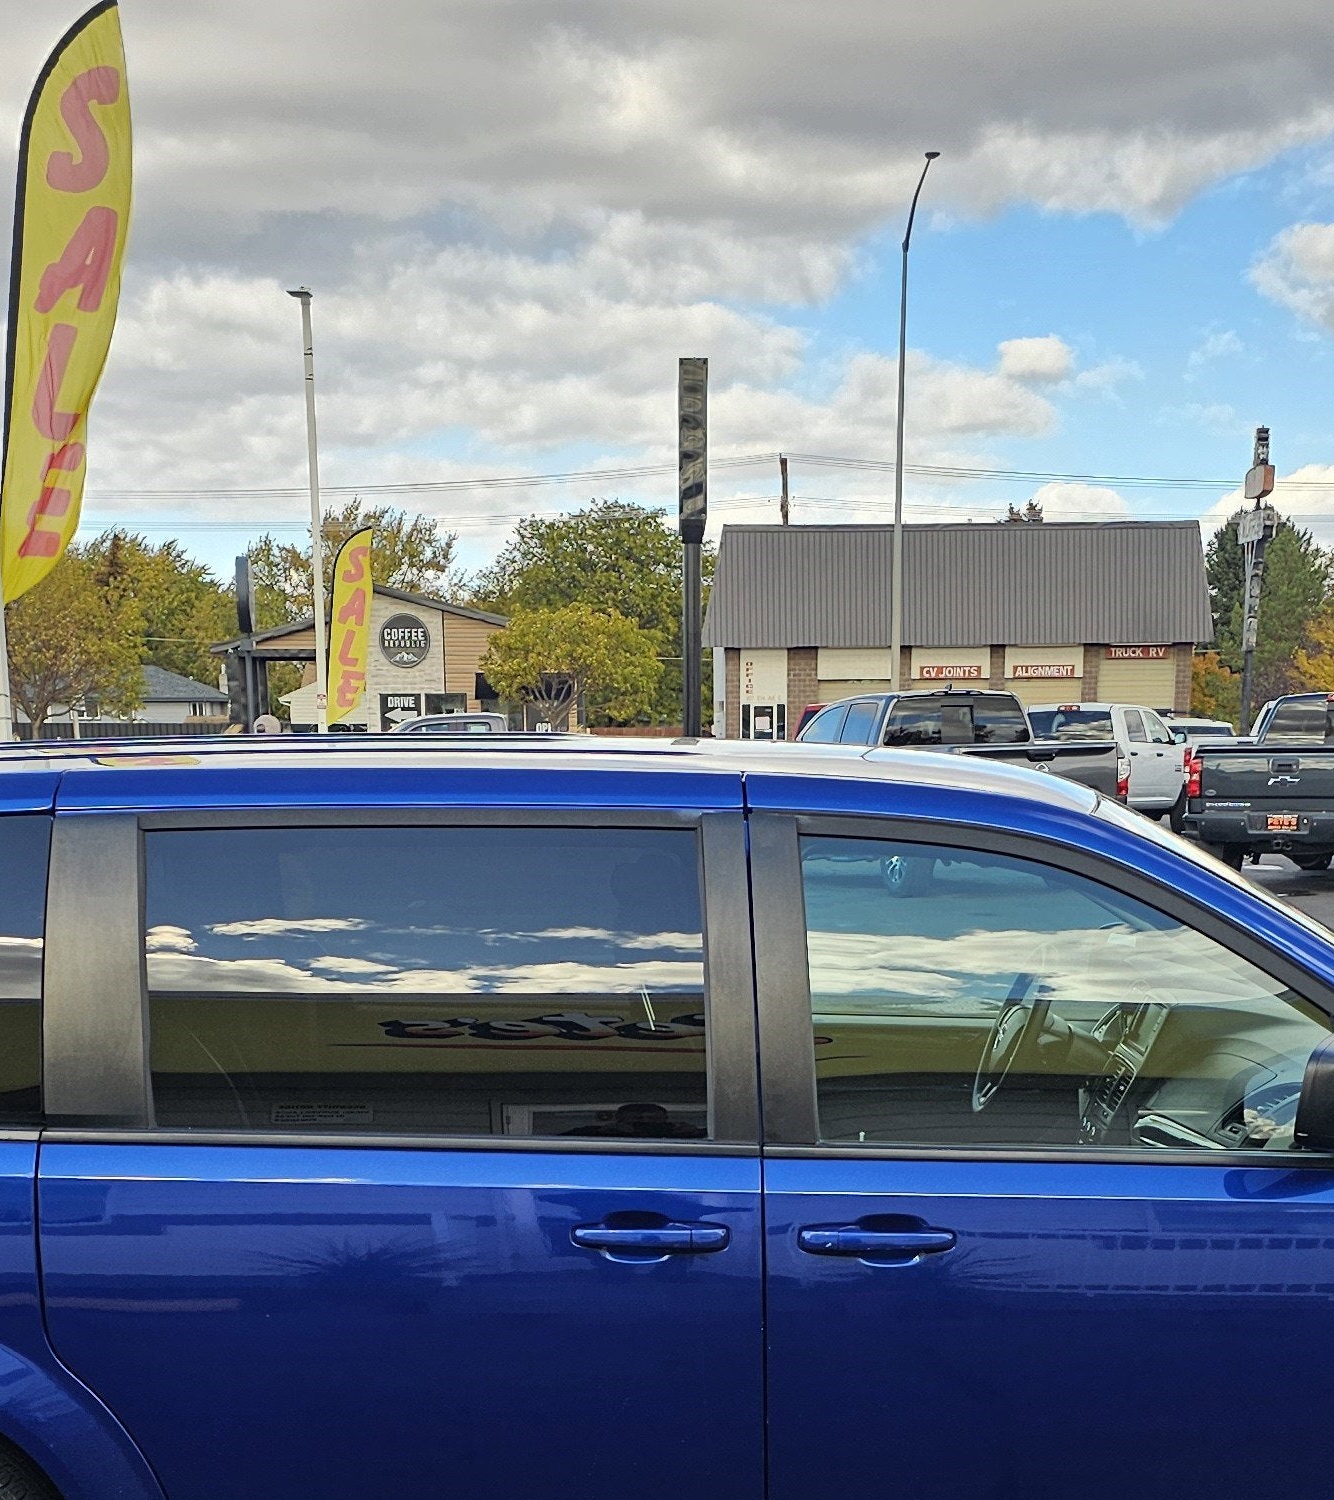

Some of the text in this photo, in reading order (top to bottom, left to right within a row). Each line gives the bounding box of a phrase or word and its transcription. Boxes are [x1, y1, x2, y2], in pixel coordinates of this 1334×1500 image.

[18, 65, 121, 559] SALE
[336, 545, 369, 709] SALE
[383, 628, 425, 640] COFFEE
[384, 640, 426, 648] REPUBLIC
[1110, 647, 1166, 658] TRUCK RV
[922, 666, 979, 678] CV JOINTS
[1015, 665, 1074, 677] ALIGNMENT
[387, 696, 416, 708] DRIVE
